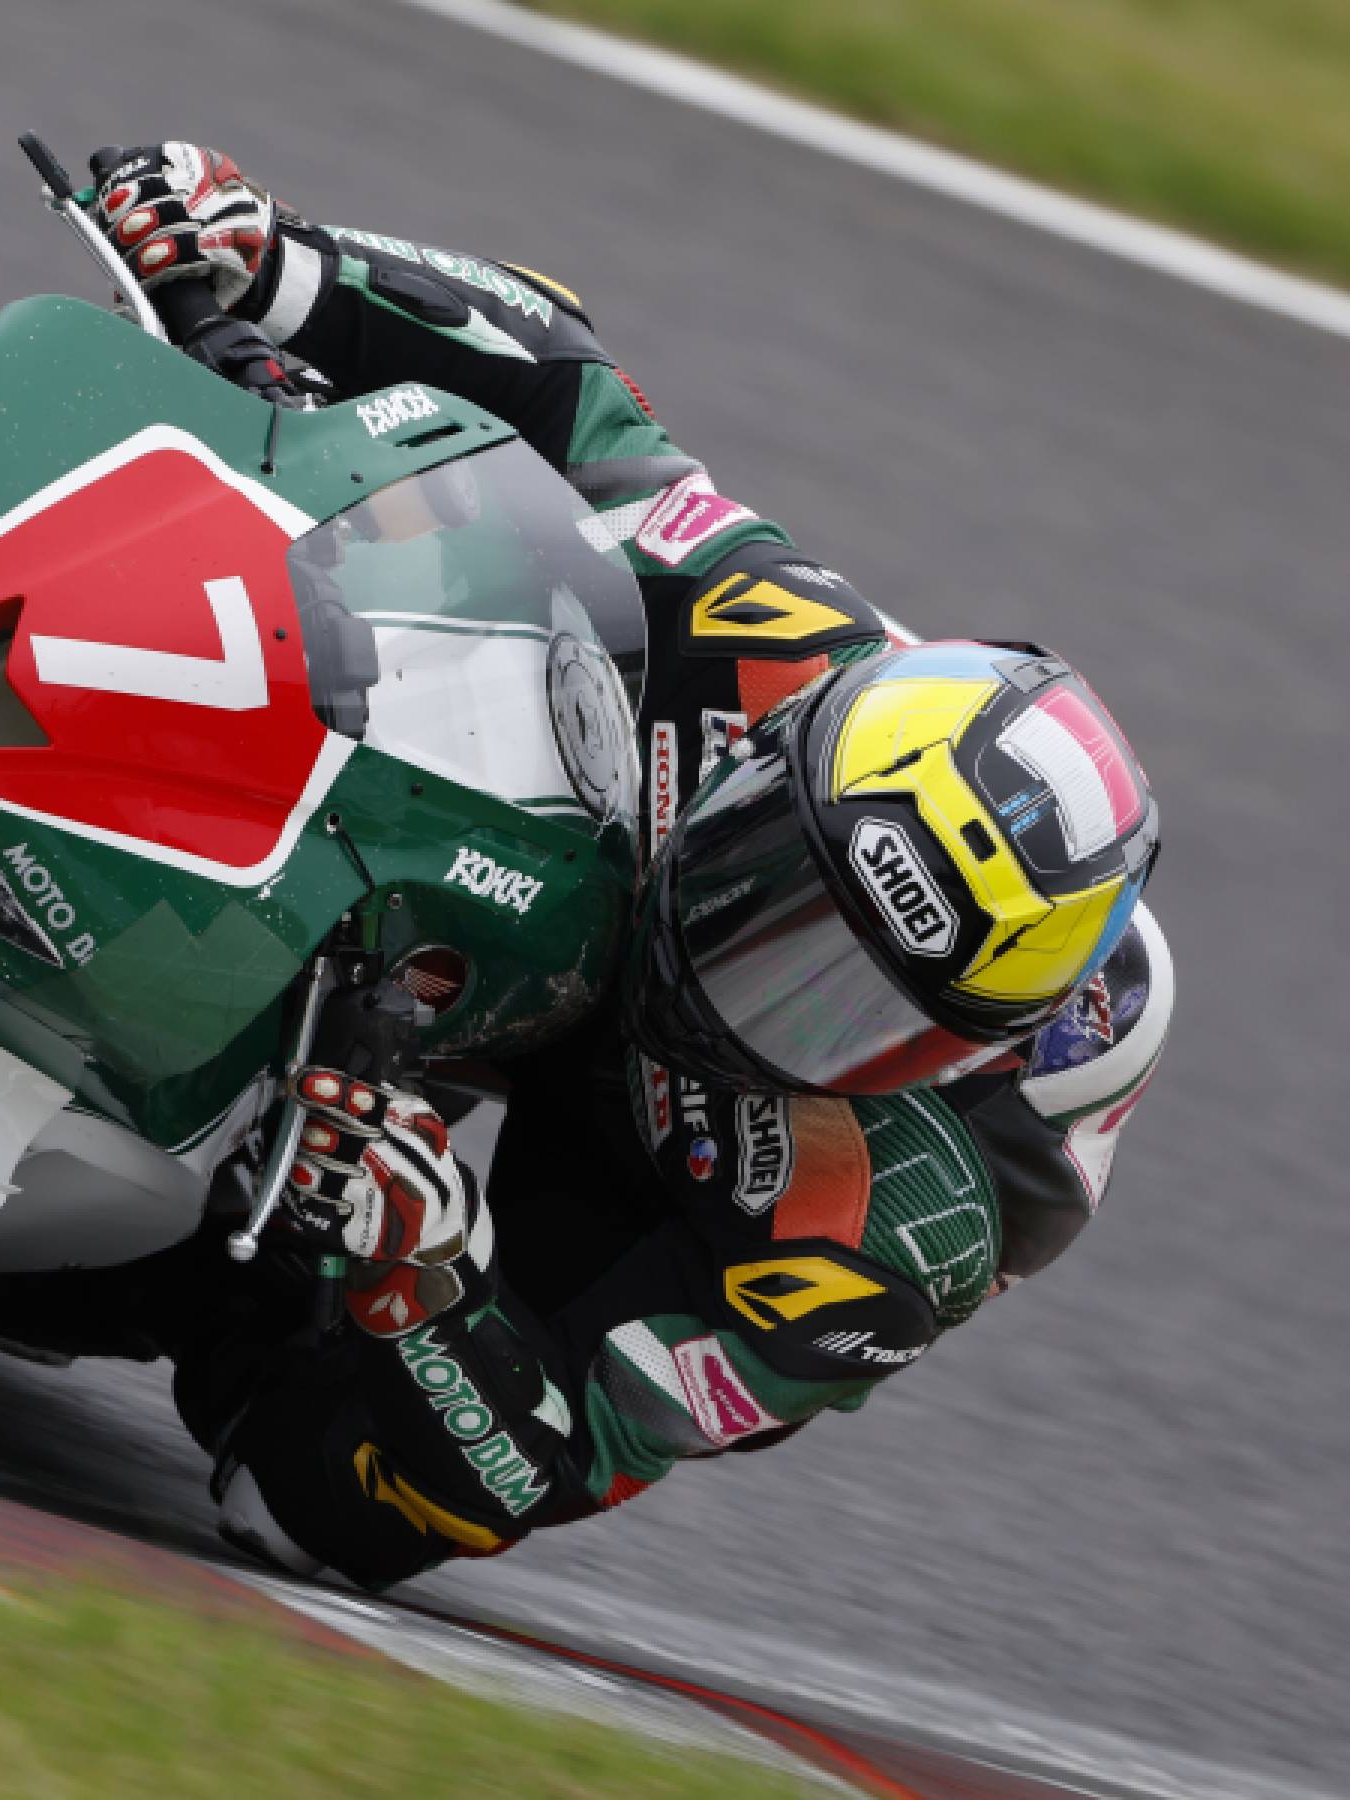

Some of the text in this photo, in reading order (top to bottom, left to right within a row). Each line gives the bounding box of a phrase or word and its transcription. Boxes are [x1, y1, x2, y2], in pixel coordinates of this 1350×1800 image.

[425, 249, 553, 327] MOTO
[30, 576, 269, 710] 7
[3, 842, 75, 928] MOTO
[861, 834, 946, 943] SHOEI
[749, 1094, 783, 1196] SHOEI
[396, 1326, 551, 1516] MOTO BUM
